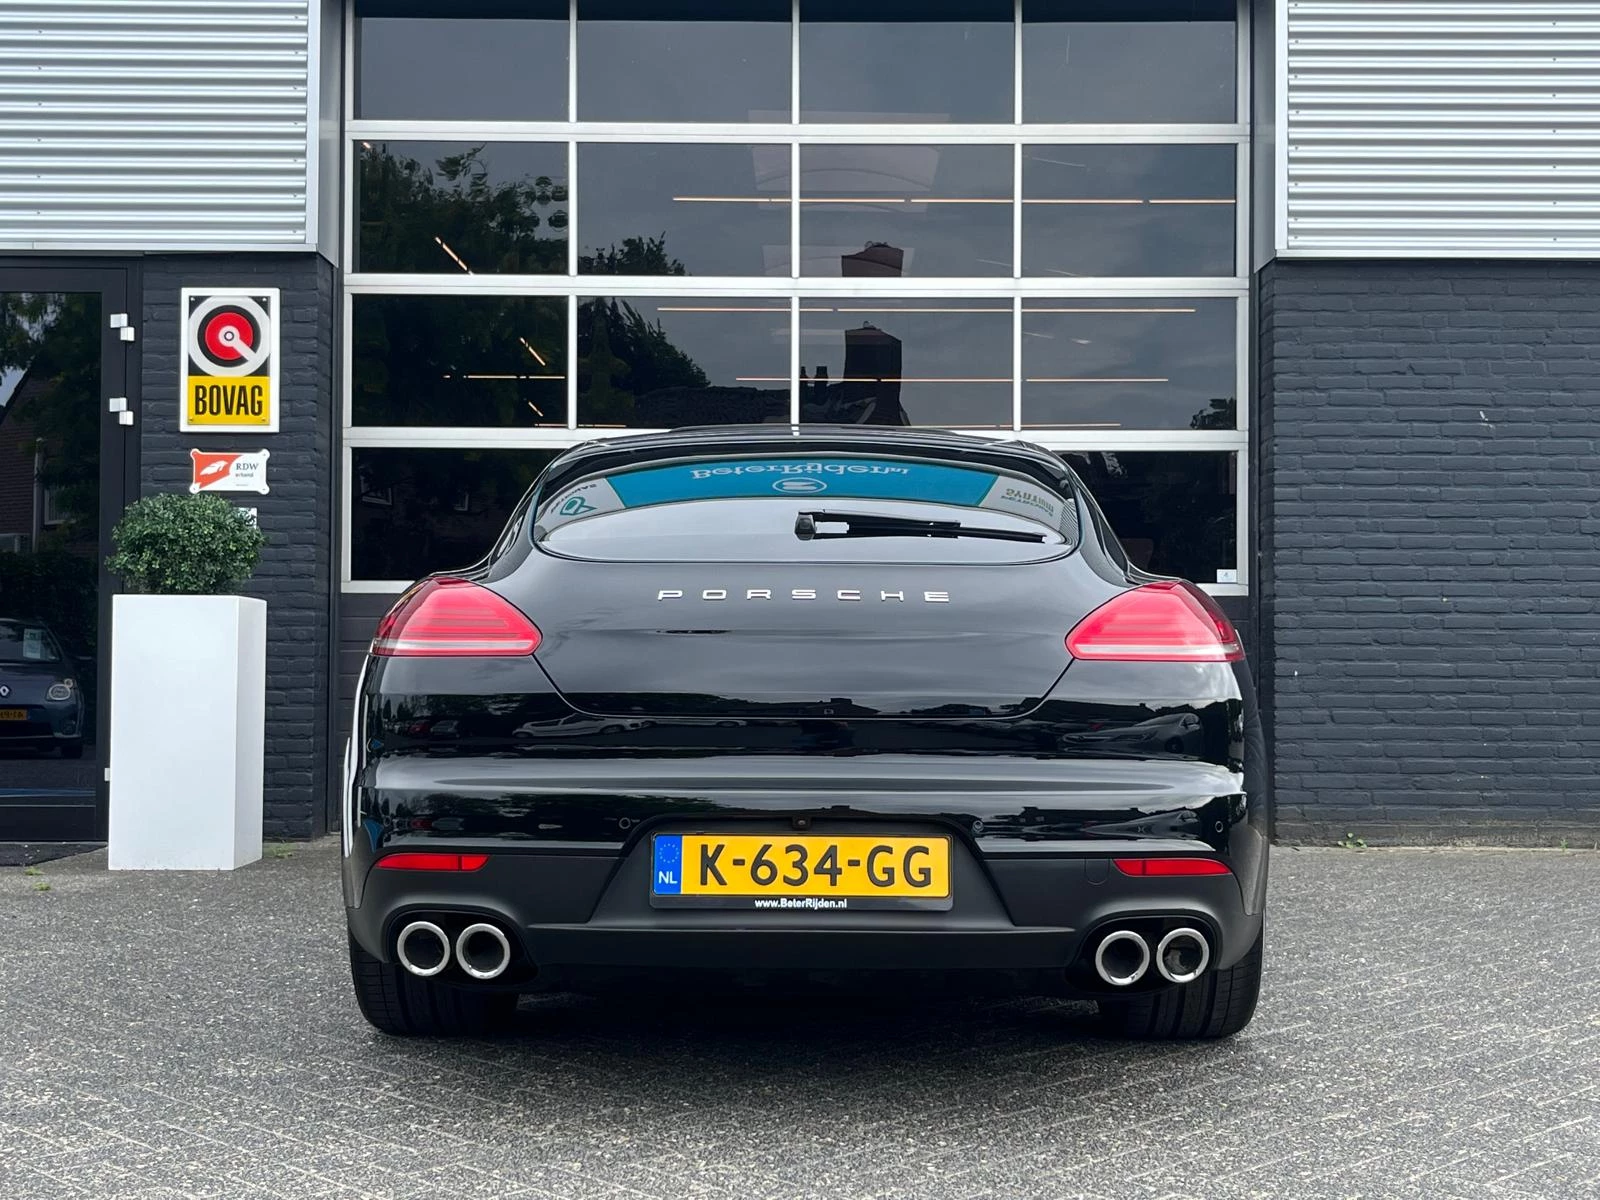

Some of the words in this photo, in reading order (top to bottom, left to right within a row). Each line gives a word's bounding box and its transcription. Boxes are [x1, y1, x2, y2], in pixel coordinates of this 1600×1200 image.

[195, 386, 263, 416] BOVAG
[236, 463, 259, 471] RDW
[658, 590, 949, 602] PORSCHE
[658, 871, 678, 885] NL
[700, 844, 932, 888] K-634-GG
[755, 898, 847, 910] www.BeterRijden.nl
